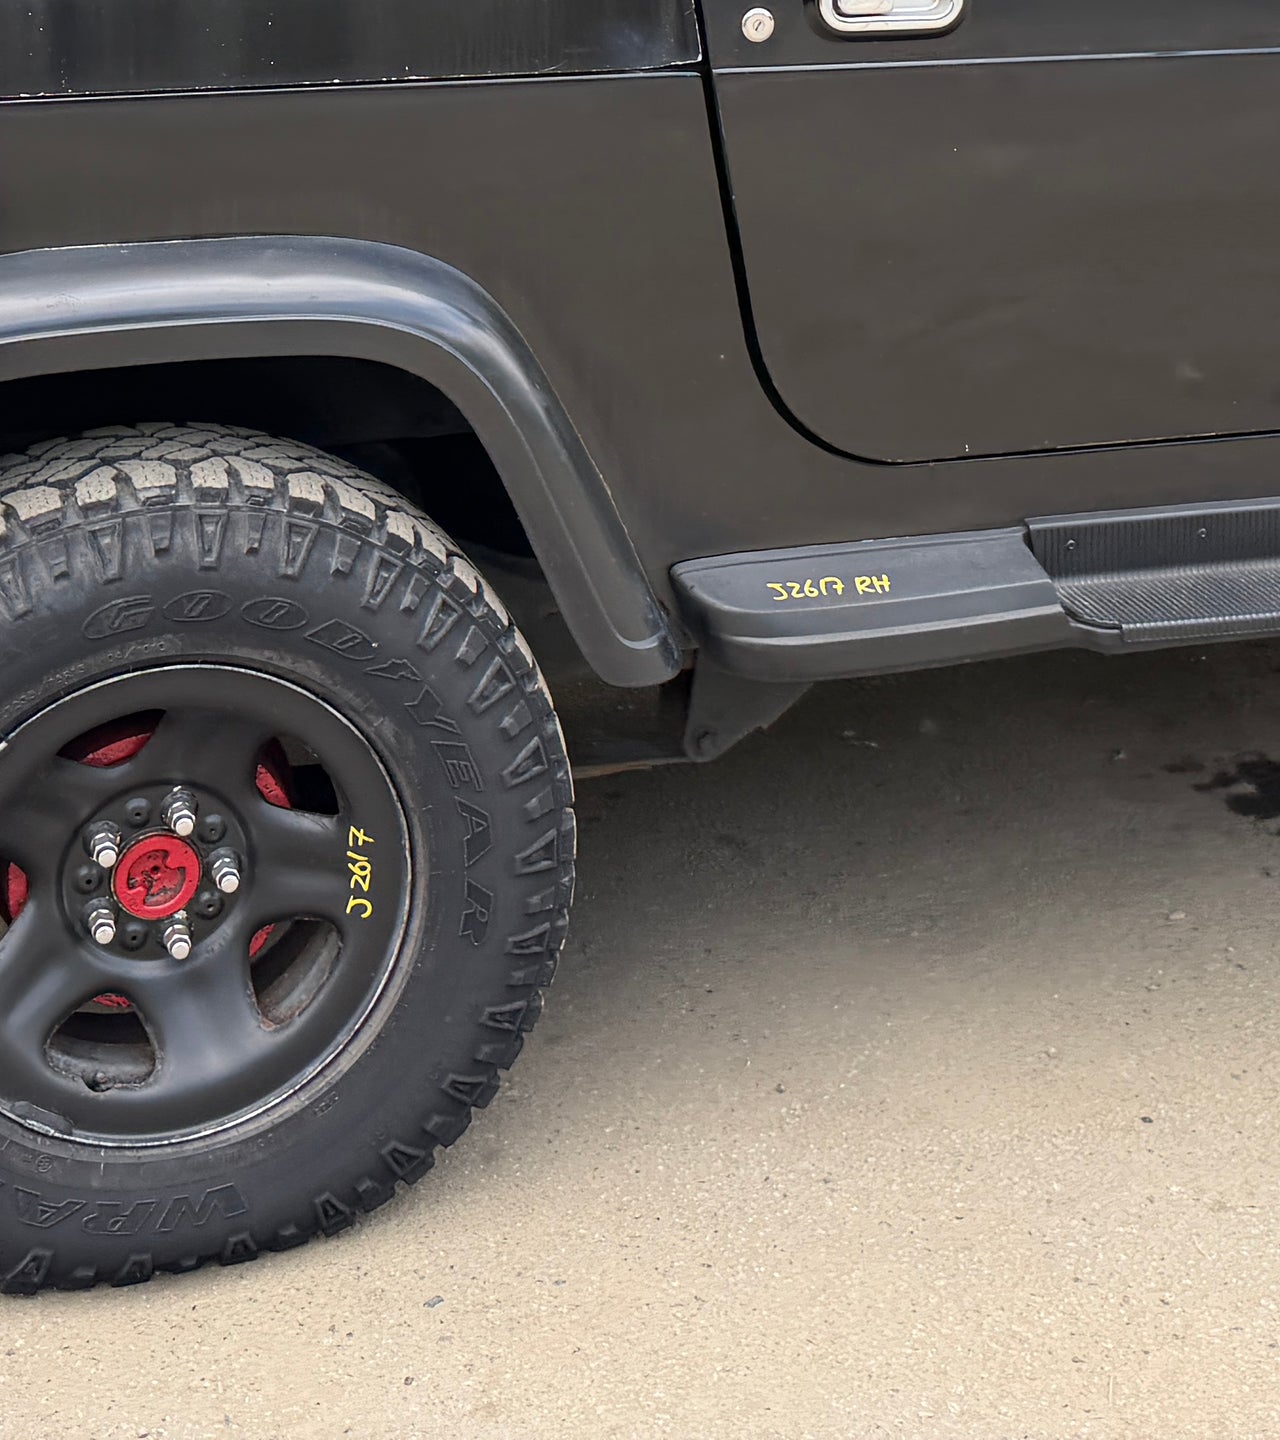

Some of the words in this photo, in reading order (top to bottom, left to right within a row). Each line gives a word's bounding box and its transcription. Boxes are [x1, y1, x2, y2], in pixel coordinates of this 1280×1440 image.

[766, 577, 845, 602] J2617
[854, 575, 892, 595] RH
[81, 588, 496, 948] GOODYEAR
[345, 826, 375, 920] J2617
